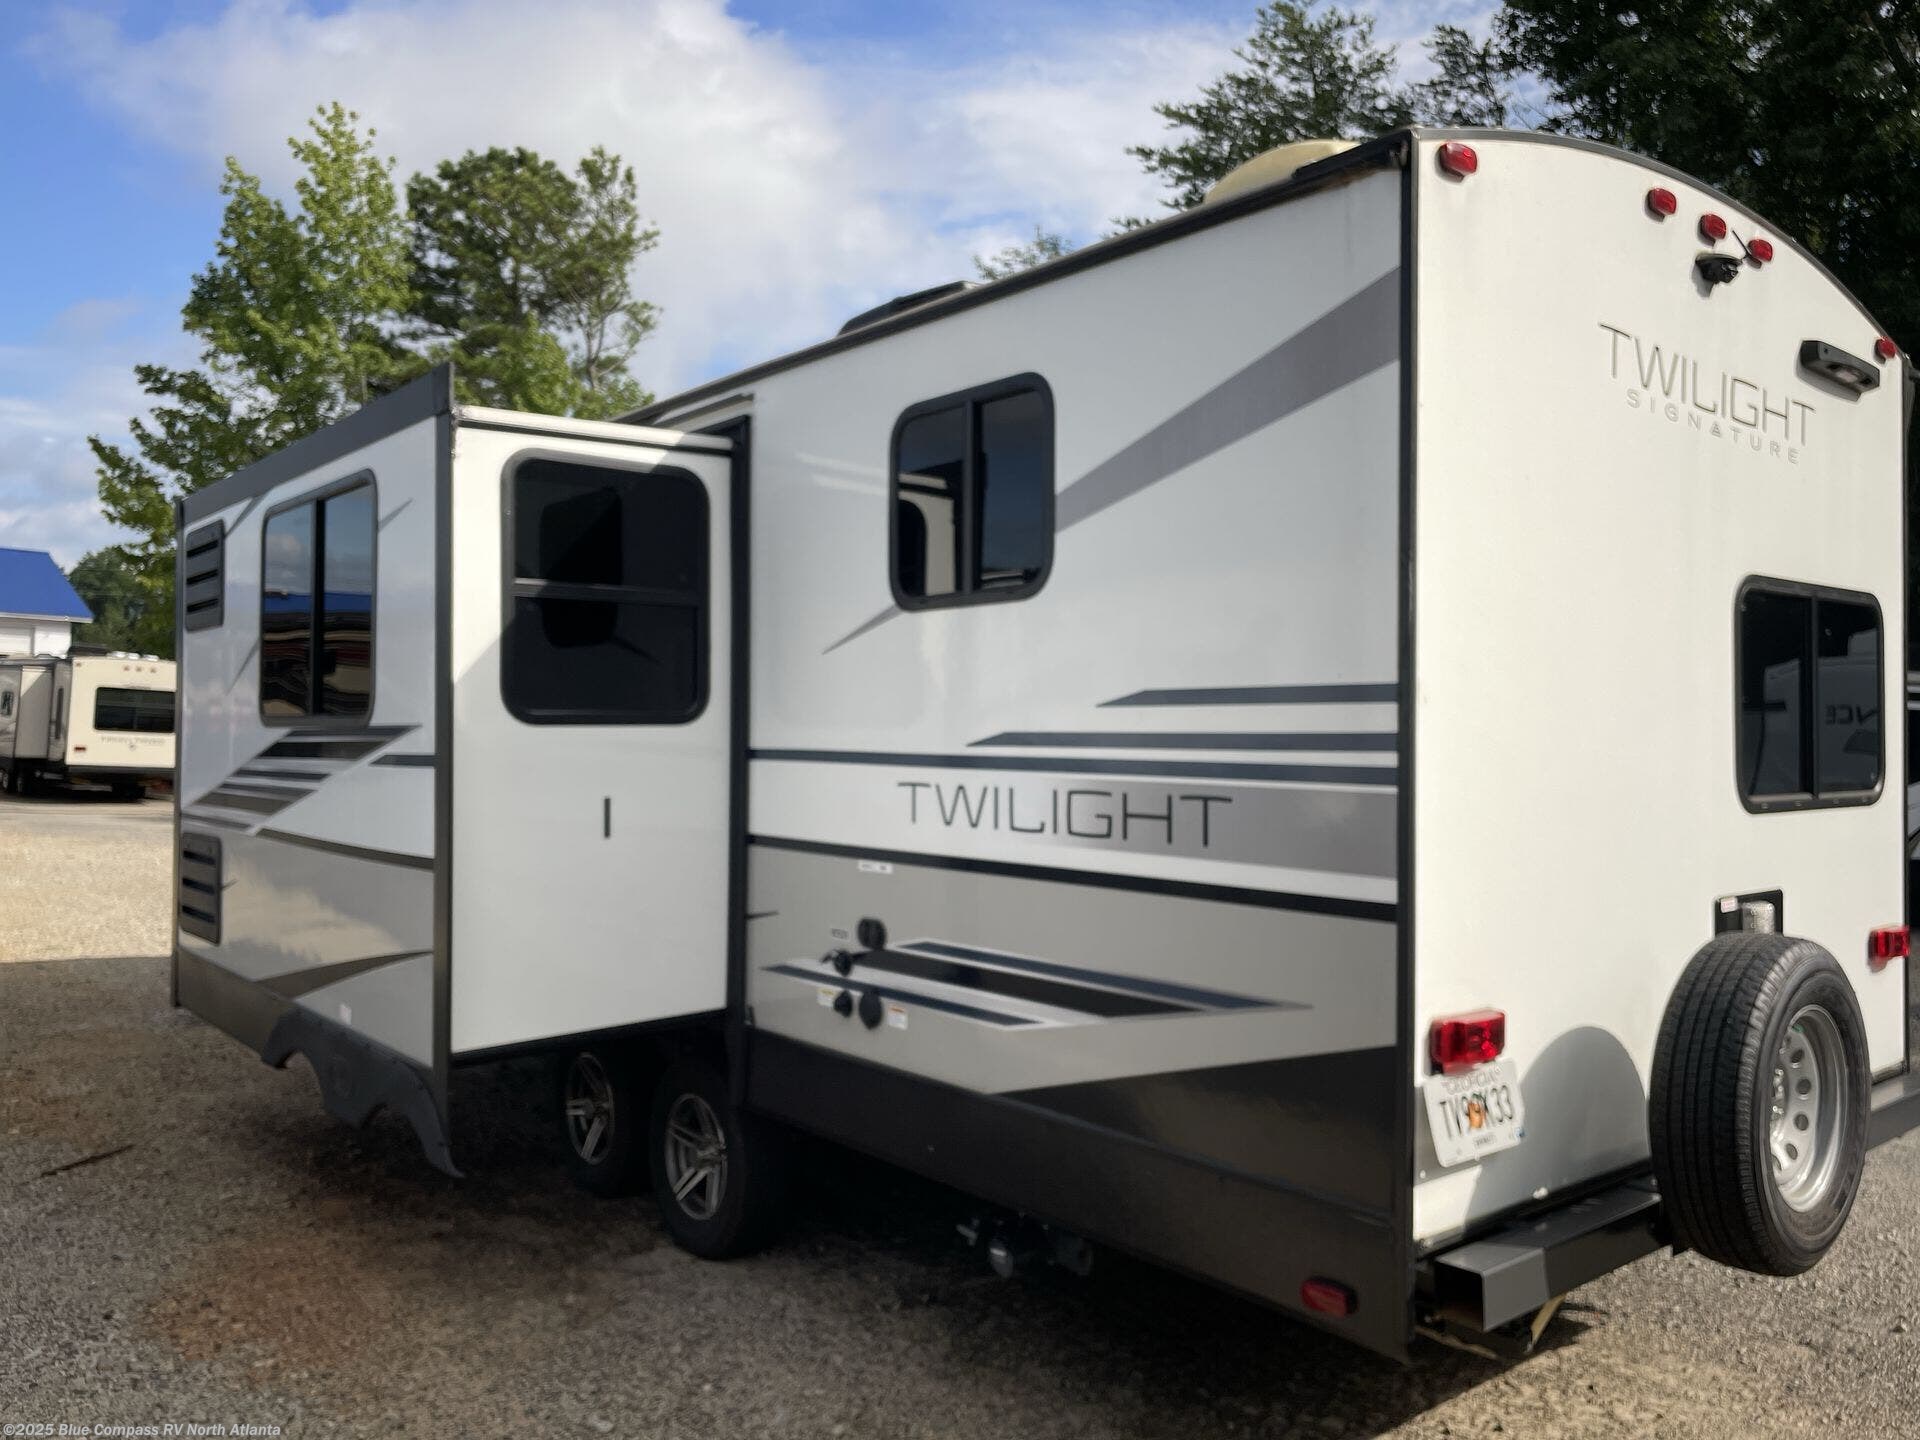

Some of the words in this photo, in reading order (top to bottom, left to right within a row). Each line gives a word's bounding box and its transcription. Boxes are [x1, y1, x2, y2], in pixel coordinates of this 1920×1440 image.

[1598, 321, 1816, 447] TWILIGHT
[1626, 388, 1800, 464] SIGNATURE
[897, 781, 1233, 848] TWILIGHT
